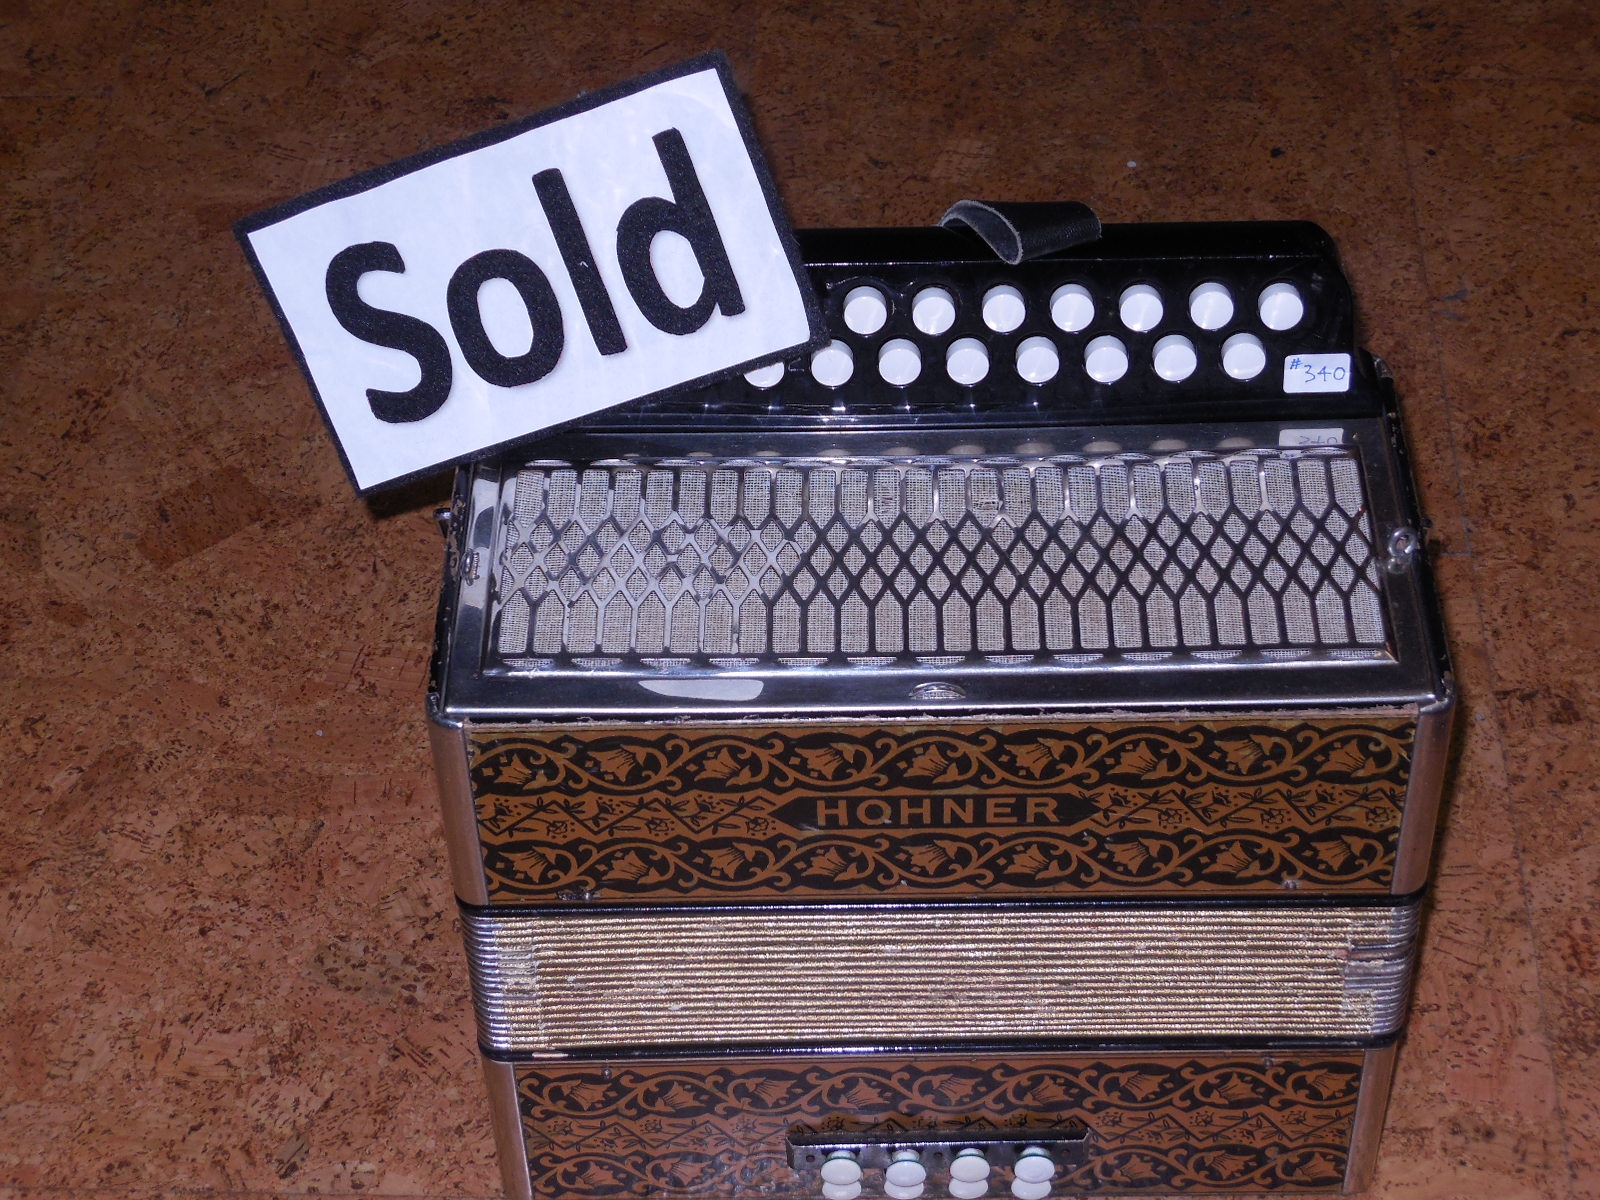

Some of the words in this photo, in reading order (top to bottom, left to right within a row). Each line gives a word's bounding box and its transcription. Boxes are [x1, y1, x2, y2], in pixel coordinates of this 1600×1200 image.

[325, 127, 746, 423] Sold
[1289, 357, 1346, 383] #340
[816, 796, 1060, 827] HOHNER
